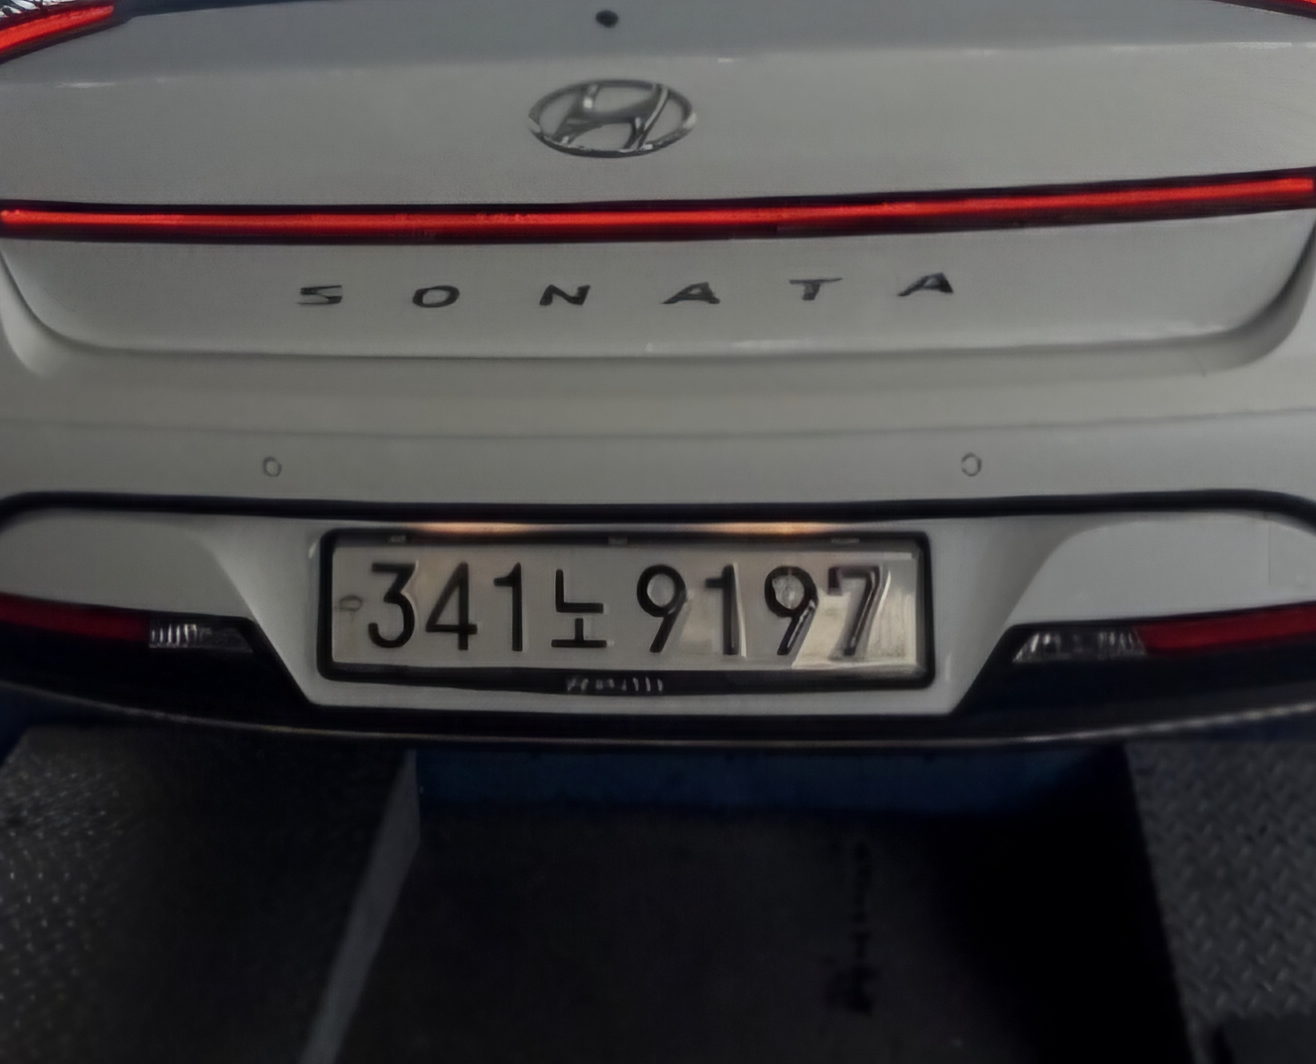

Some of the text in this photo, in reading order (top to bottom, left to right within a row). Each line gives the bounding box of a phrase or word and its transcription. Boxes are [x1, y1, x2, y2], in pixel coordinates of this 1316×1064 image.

[297, 272, 954, 308] SONATA
[367, 561, 882, 657] 341노 9197
